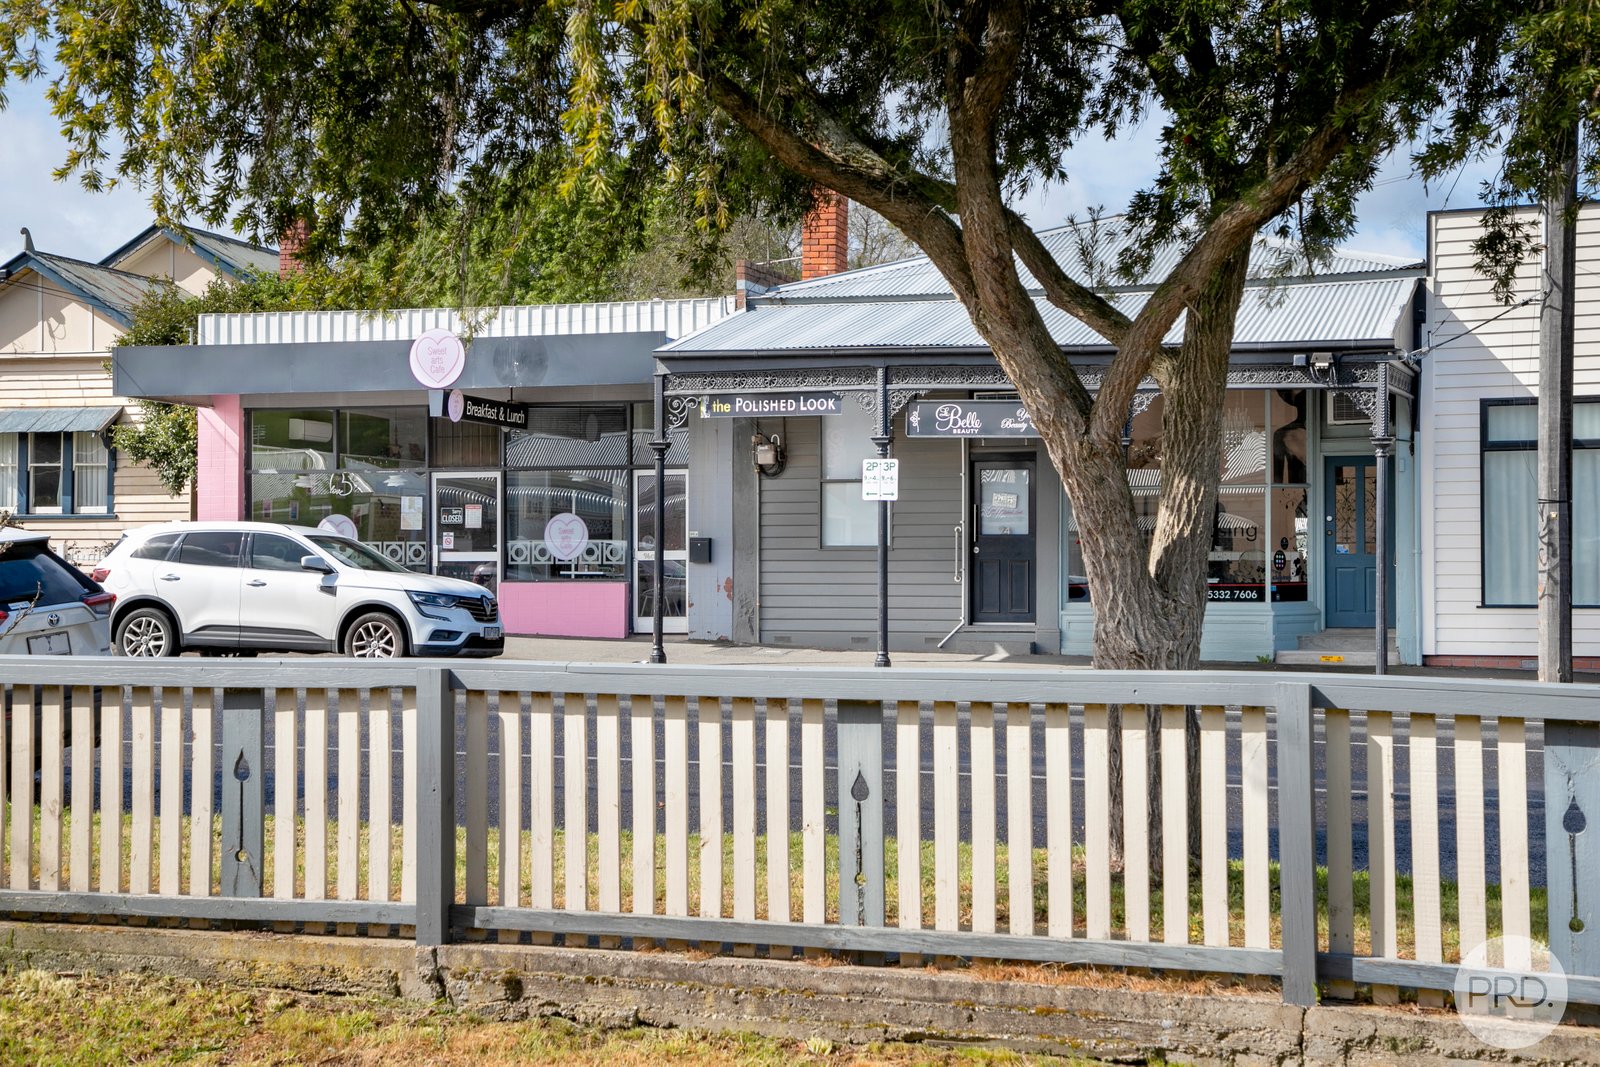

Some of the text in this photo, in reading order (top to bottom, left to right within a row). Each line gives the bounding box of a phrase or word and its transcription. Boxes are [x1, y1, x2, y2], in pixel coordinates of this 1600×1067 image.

[427, 346, 447, 356] Sweet
[430, 356, 444, 364] arts
[712, 396, 836, 413] the POLISHED LOOK
[466, 401, 498, 420] Breakfast
[498, 406, 505, 421] &
[506, 407, 525, 424] Lunch
[935, 403, 982, 431] Belle
[1001, 417, 1028, 432] Beauty
[866, 462, 879, 471] 2P
[883, 462, 896, 471] 3P
[441, 514, 463, 523] CLOSED
[1207, 590, 1258, 599] 5332 7606
